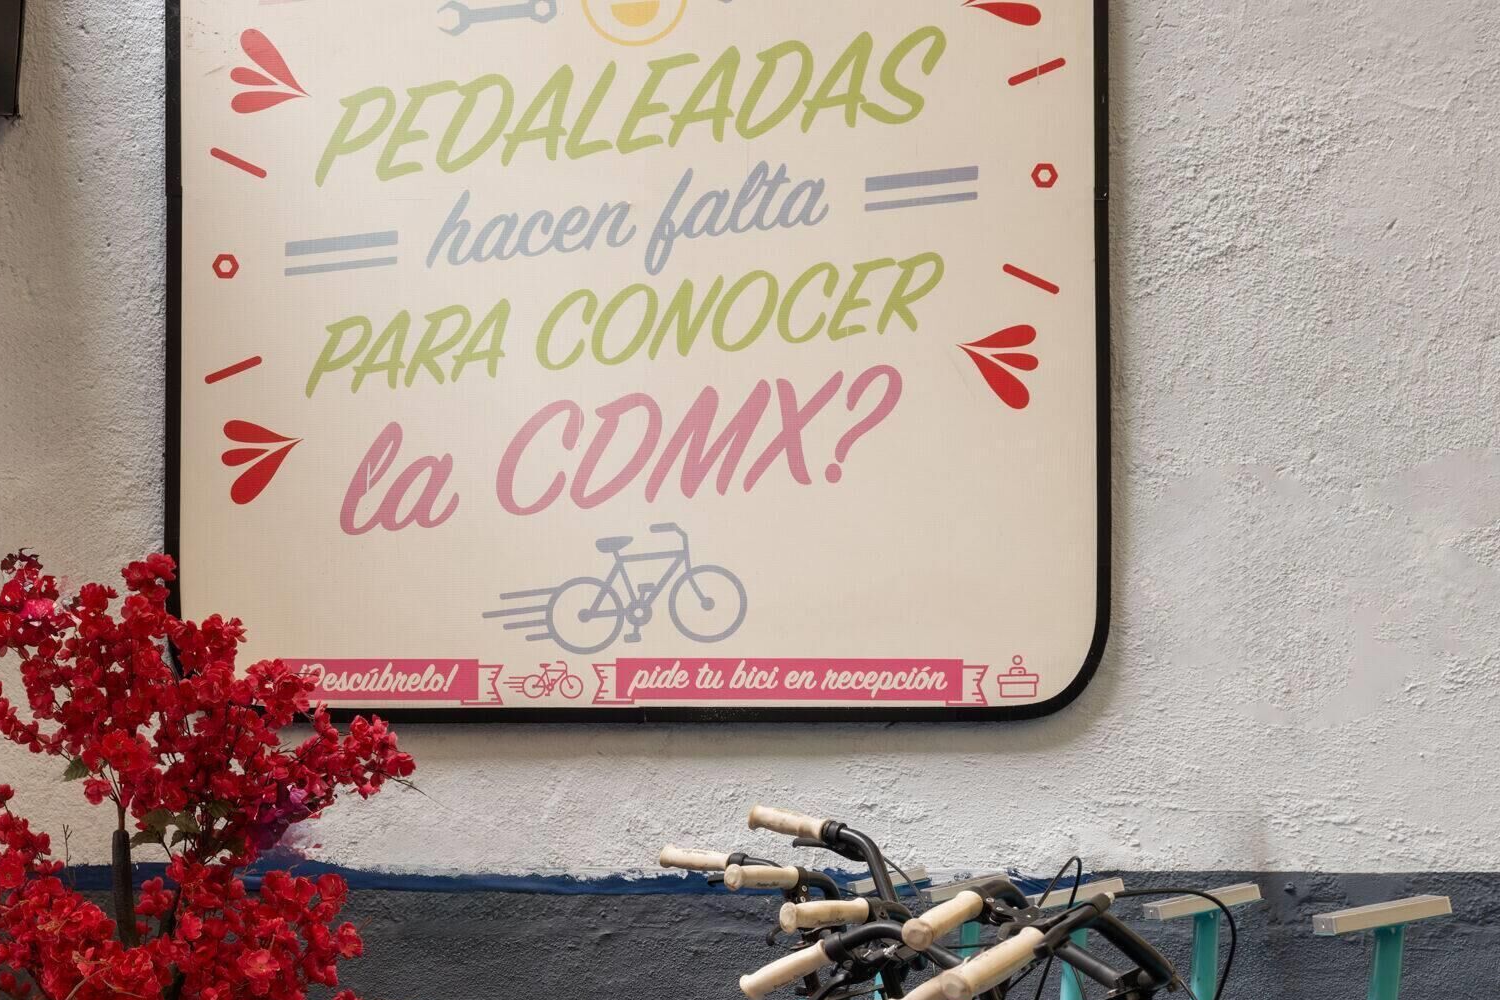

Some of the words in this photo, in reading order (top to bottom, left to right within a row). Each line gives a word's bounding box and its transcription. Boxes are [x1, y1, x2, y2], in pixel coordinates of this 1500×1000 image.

[314, 25, 947, 188] PEDALEADAS
[426, 189, 636, 269] hacen
[644, 161, 829, 277] falta
[305, 298, 511, 399] PARA
[536, 251, 945, 372] CONOCER
[339, 421, 460, 536] la
[496, 364, 903, 517] CDMX?
[627, 660, 690, 697] pide
[695, 662, 724, 690] tu
[729, 659, 780, 690] bici
[784, 668, 817, 690] en
[821, 665, 948, 698] recepción
